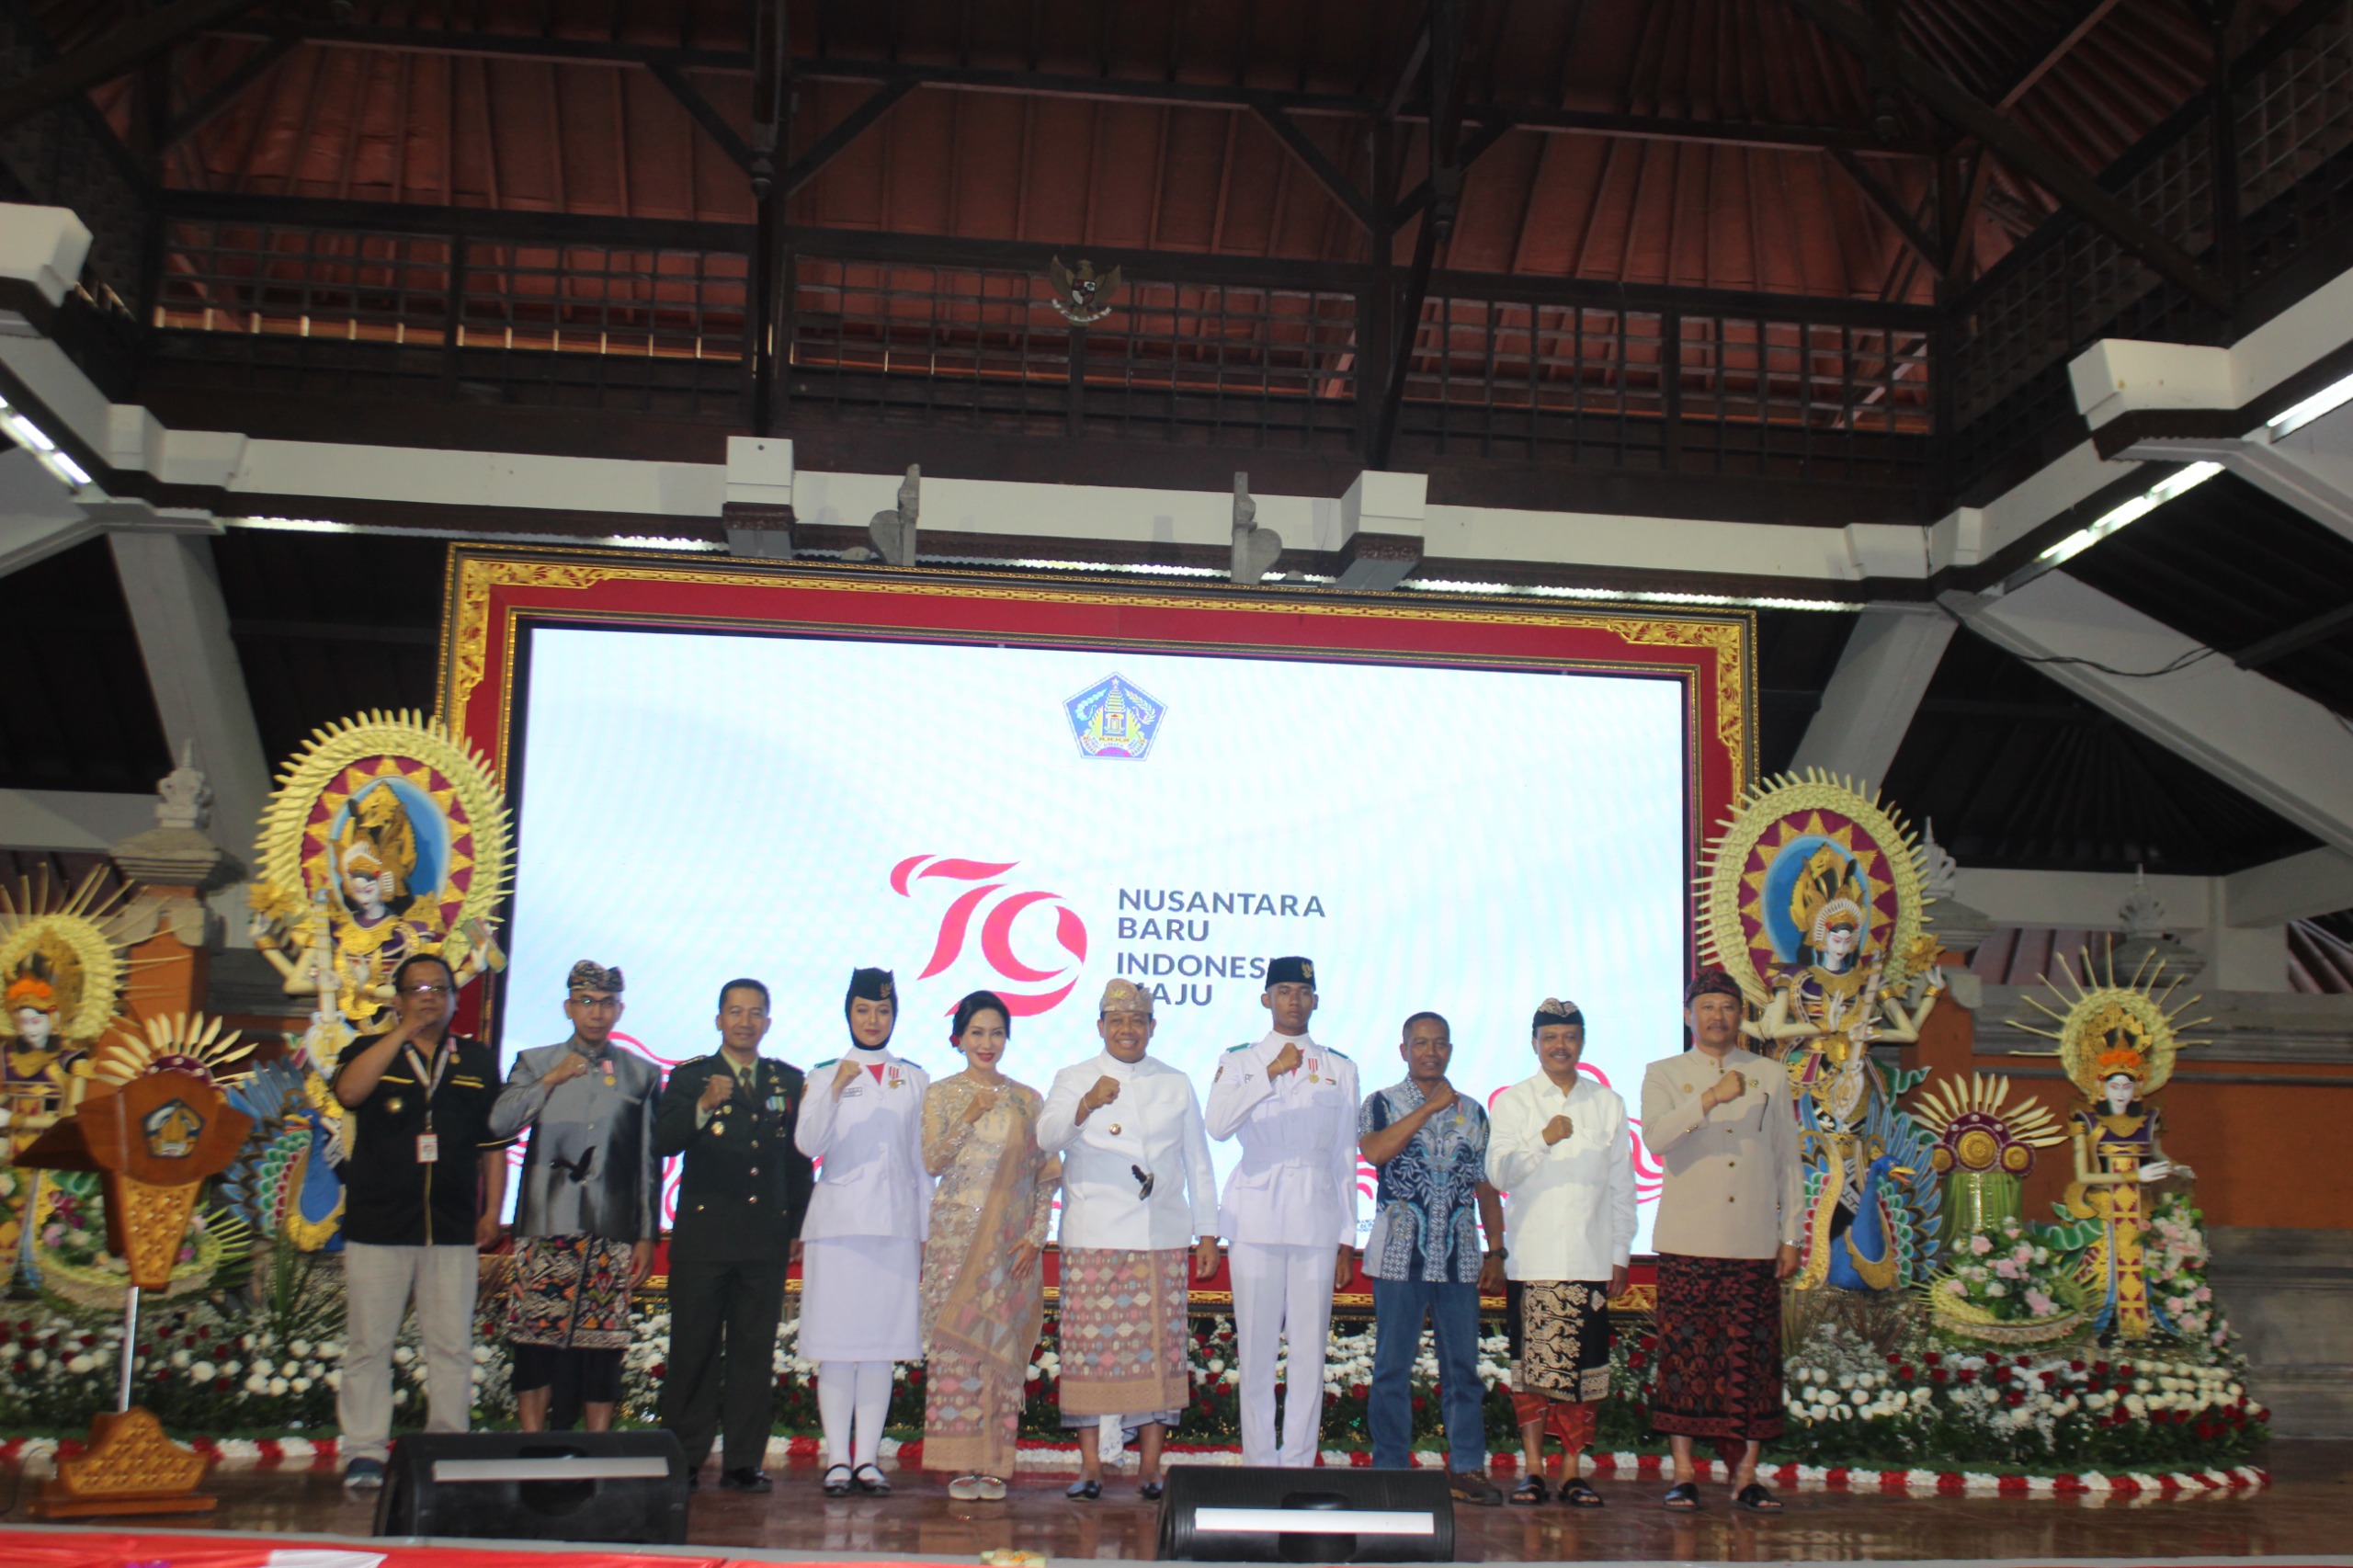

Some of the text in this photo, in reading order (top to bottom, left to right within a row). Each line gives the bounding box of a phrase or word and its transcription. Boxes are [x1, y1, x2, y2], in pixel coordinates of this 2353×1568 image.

[1119, 888, 1326, 917] NUSANTARA
[1118, 917, 1210, 941] BARU
[1117, 952, 1275, 979] INDONES
[1136, 983, 1212, 1006] AJU
